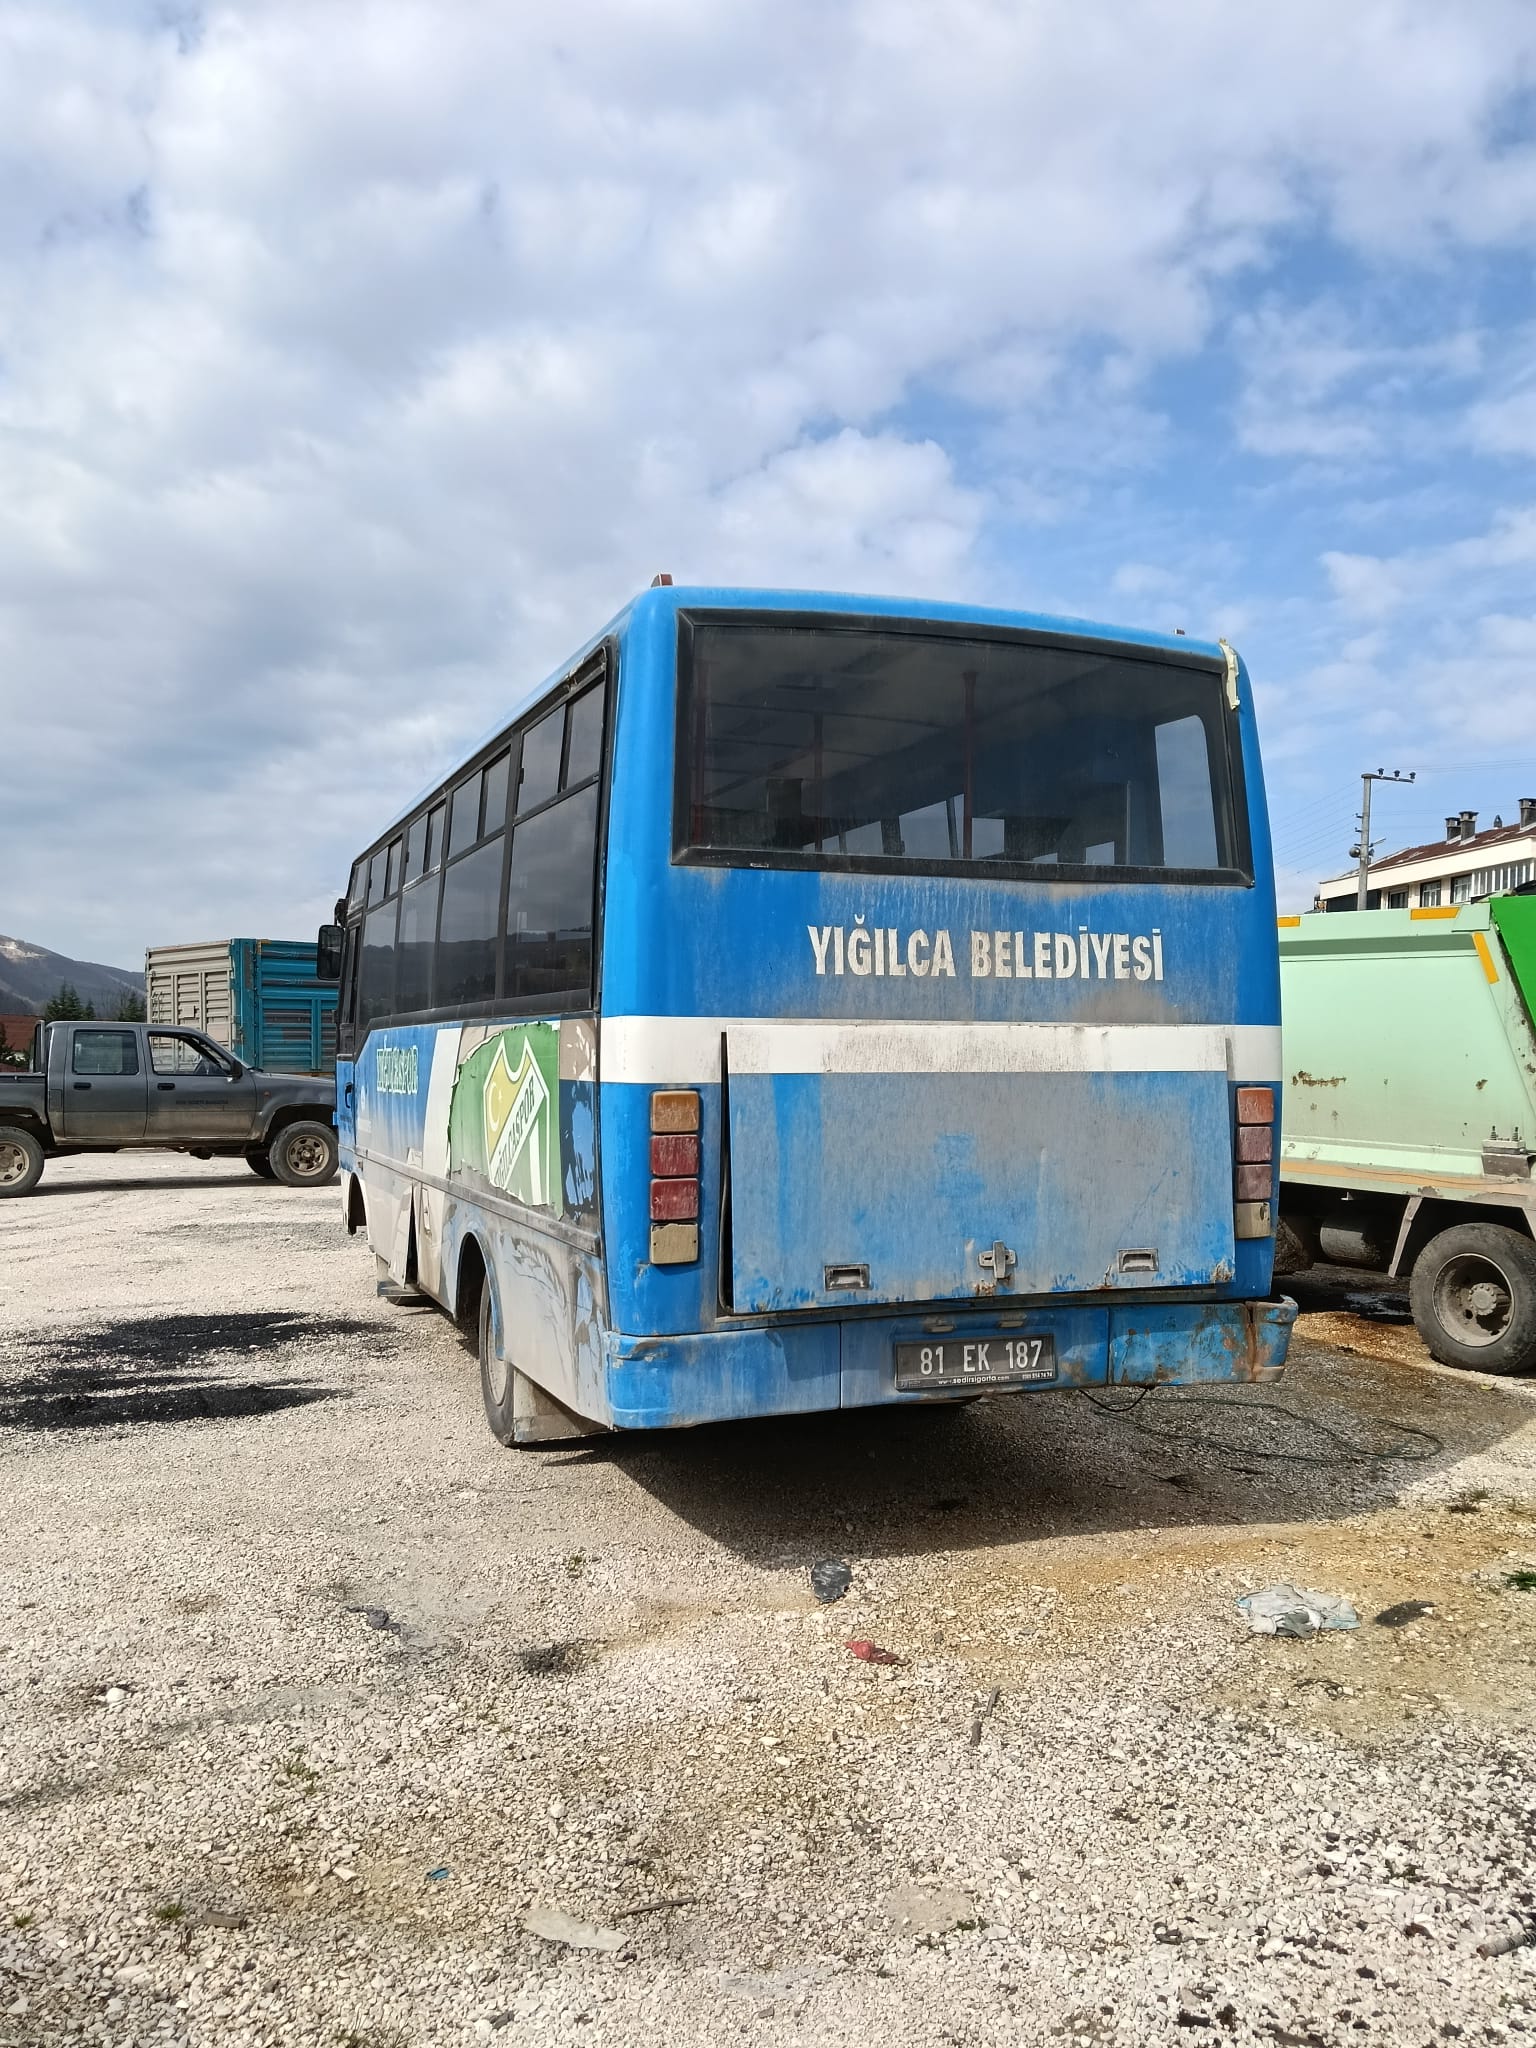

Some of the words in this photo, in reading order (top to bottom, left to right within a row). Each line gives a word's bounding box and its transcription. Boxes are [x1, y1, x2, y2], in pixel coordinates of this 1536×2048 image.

[807, 914, 956, 977] YIĞILCA
[970, 926, 1164, 981] BELEDİYESİ
[920, 1346, 944, 1375] 81
[963, 1343, 991, 1372] EK
[1005, 1340, 1043, 1369] 187
